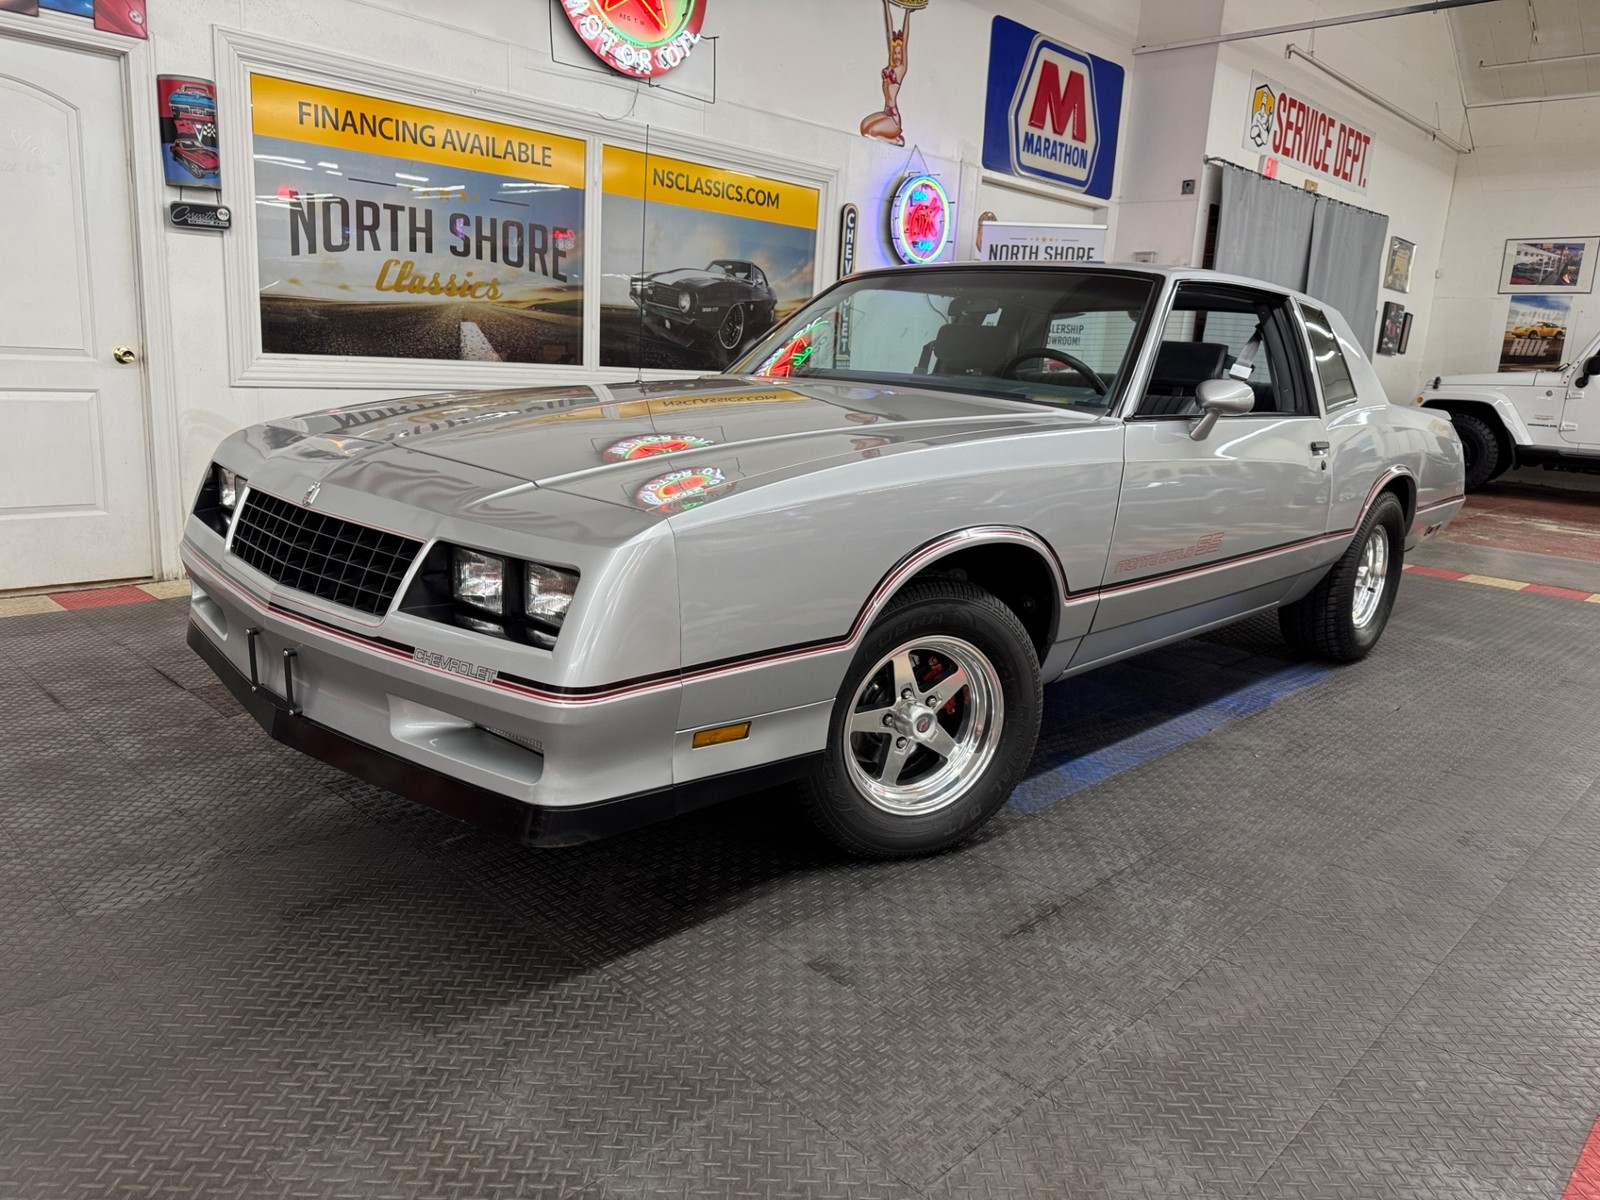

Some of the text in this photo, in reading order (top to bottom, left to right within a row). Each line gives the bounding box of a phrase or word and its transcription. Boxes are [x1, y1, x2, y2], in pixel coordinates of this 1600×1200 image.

[563, 0, 653, 75] MOTOR
[655, 29, 701, 69] OIL
[1028, 59, 1087, 144] M
[297, 100, 553, 169] FINANCING AVAILABLE
[1022, 131, 1088, 169] MARATHON
[1272, 92, 1371, 188] SERVICE DEPT.
[652, 168, 780, 209] NSCLASSICS.COM
[288, 189, 571, 283] NORTH SHORE
[988, 243, 1095, 262] NORTH SHORE
[375, 258, 504, 301] Classics
[1508, 338, 1550, 357] RIDE
[1194, 531, 1225, 556] SS
[413, 647, 497, 683] CHEVROLET
